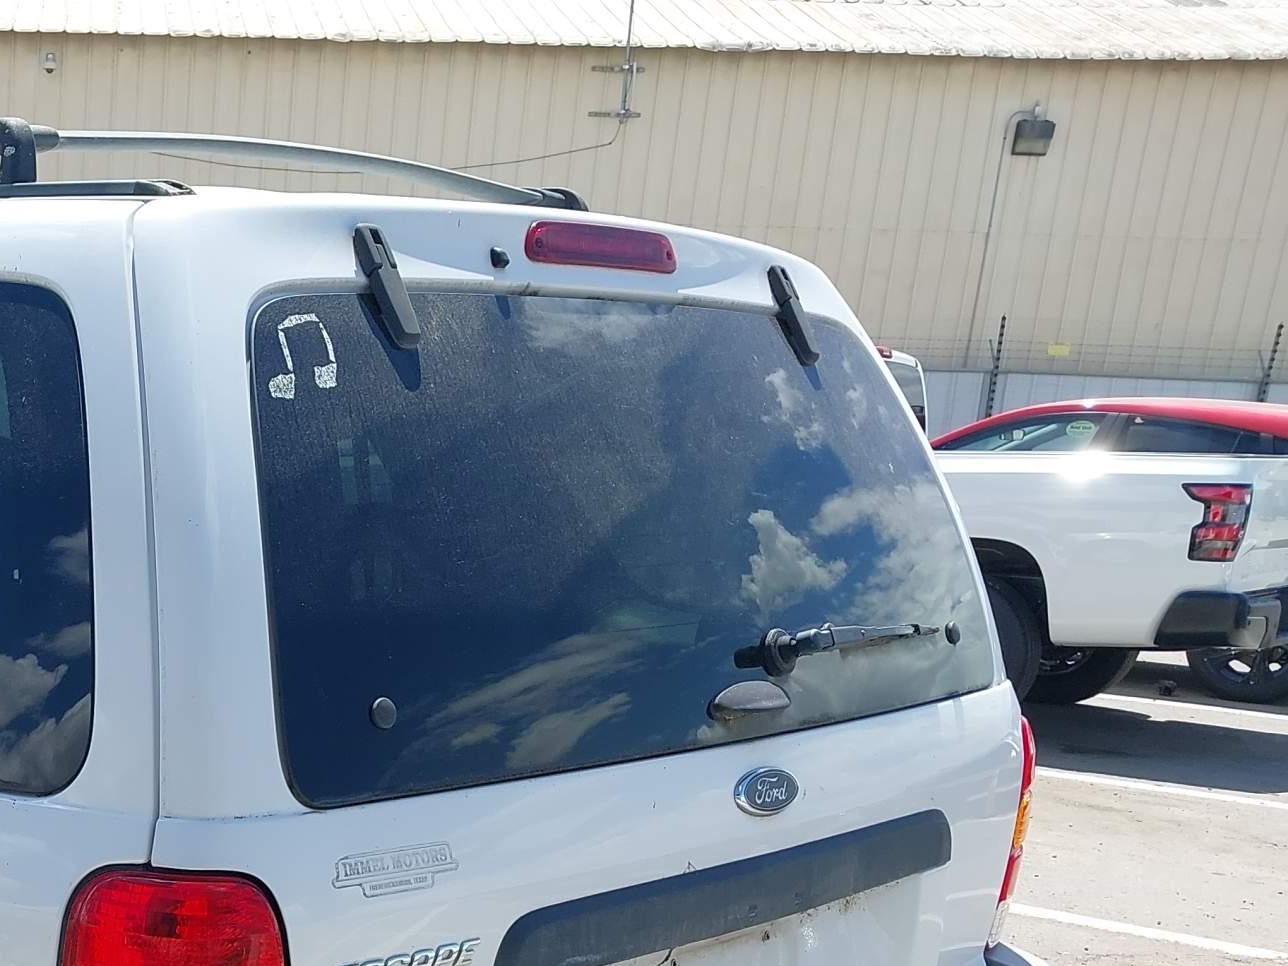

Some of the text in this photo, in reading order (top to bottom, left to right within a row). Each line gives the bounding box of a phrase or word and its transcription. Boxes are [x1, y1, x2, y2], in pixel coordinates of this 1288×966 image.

[755, 776, 788, 804] Ford
[341, 846, 449, 878] IMMEL MOTORS
